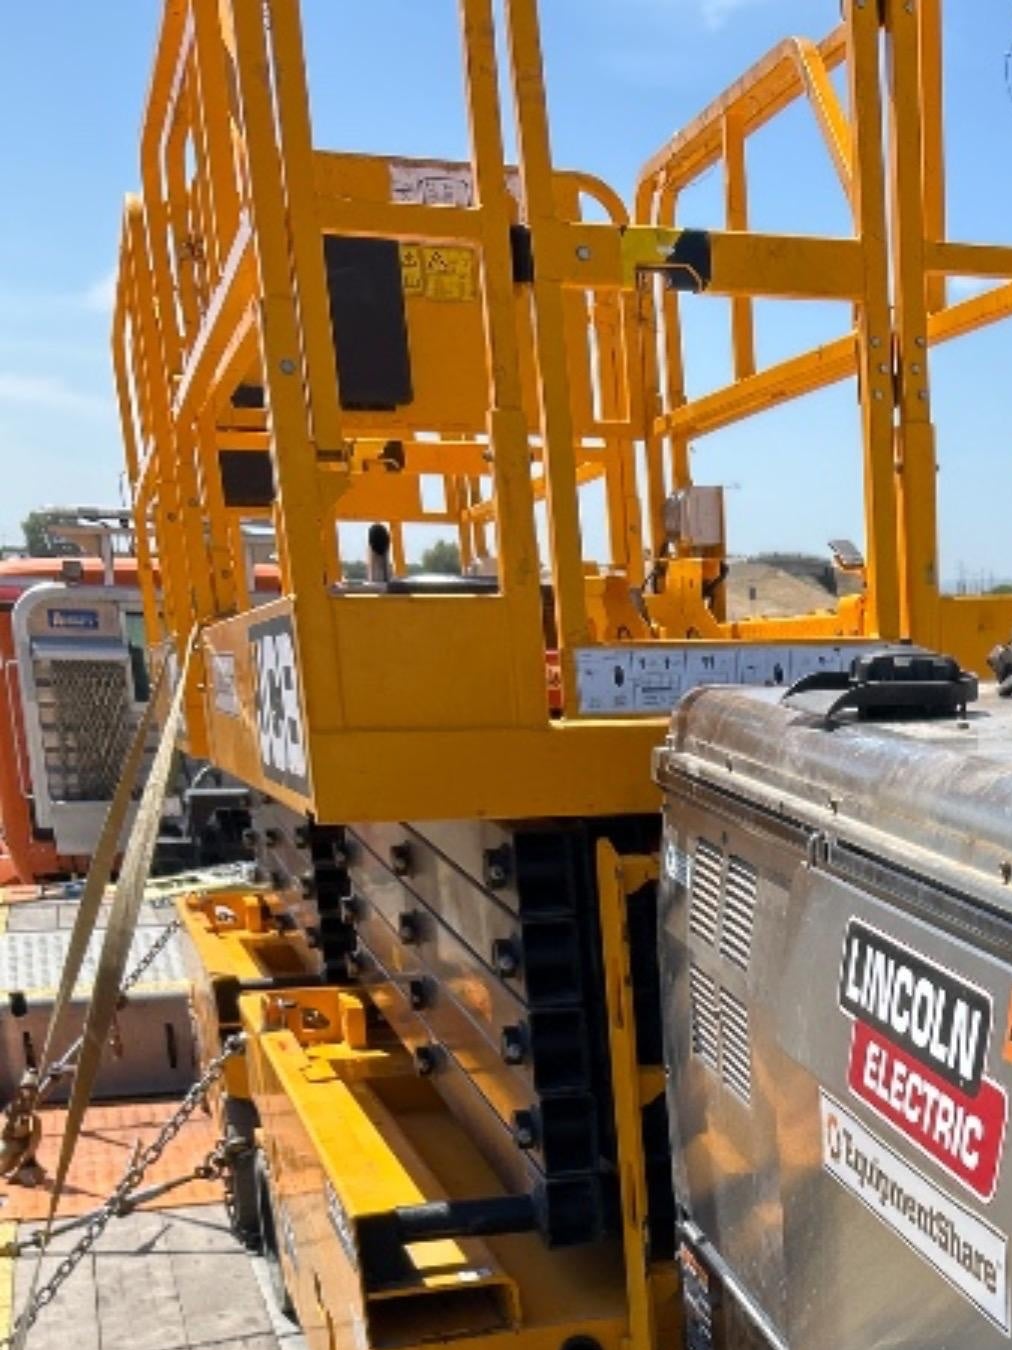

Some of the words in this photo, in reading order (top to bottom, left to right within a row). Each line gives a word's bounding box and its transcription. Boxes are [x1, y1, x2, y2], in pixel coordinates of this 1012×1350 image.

[845, 937, 983, 1081] LINCOLN
[862, 1039, 986, 1172] ELECTRIC
[840, 1128, 998, 1296] EquipmentShare
